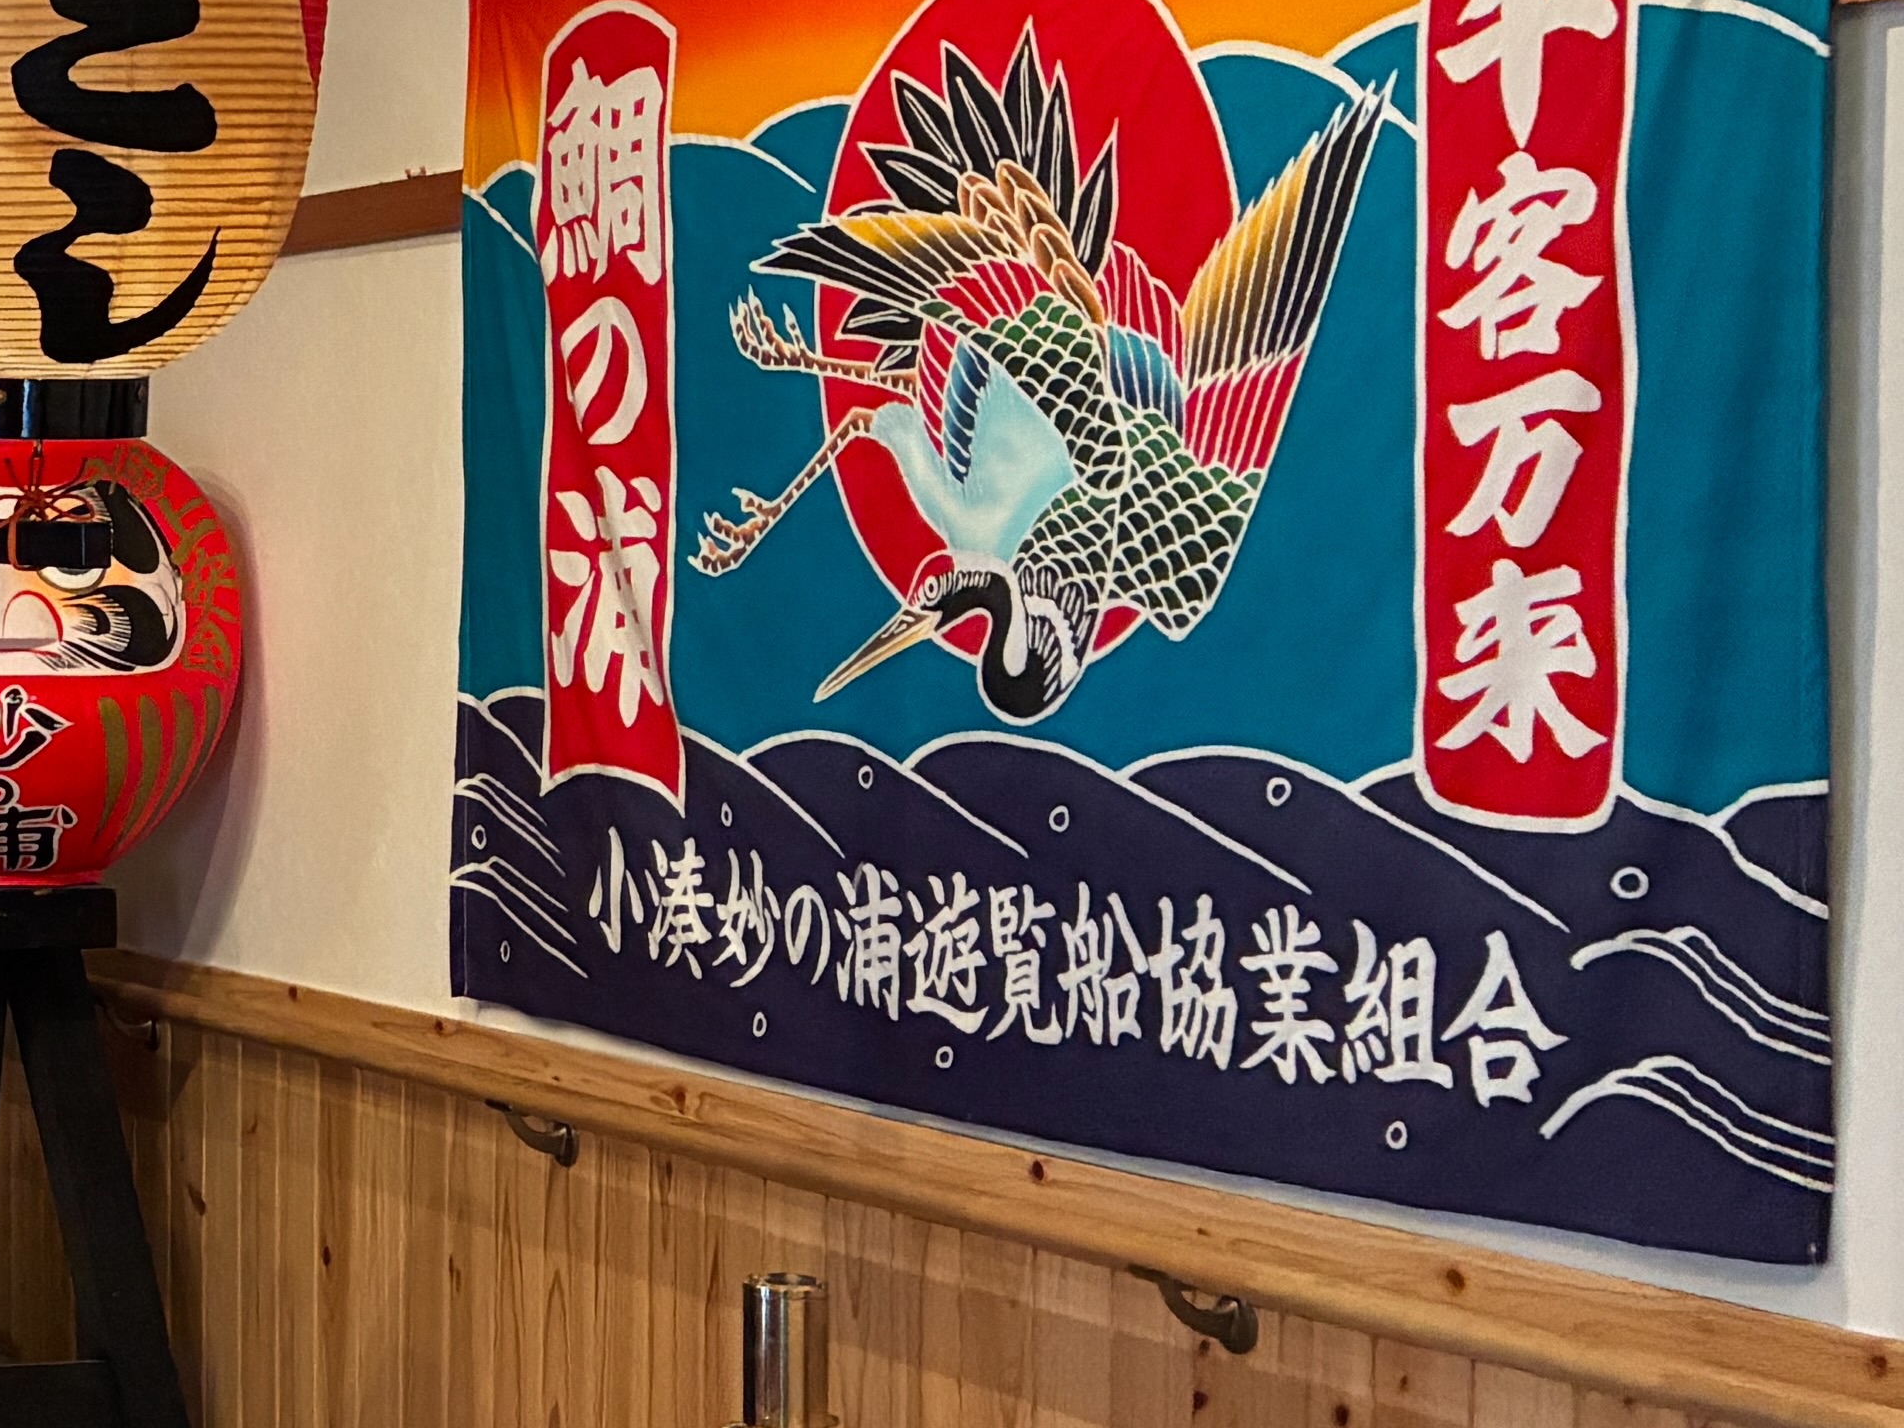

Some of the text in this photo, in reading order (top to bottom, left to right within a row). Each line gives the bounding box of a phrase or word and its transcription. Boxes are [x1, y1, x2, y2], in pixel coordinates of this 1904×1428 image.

[542, 56, 663, 728] 鯛の浦
[589, 825, 1570, 1107] 小湊妙の浦遊覧船協業組合
